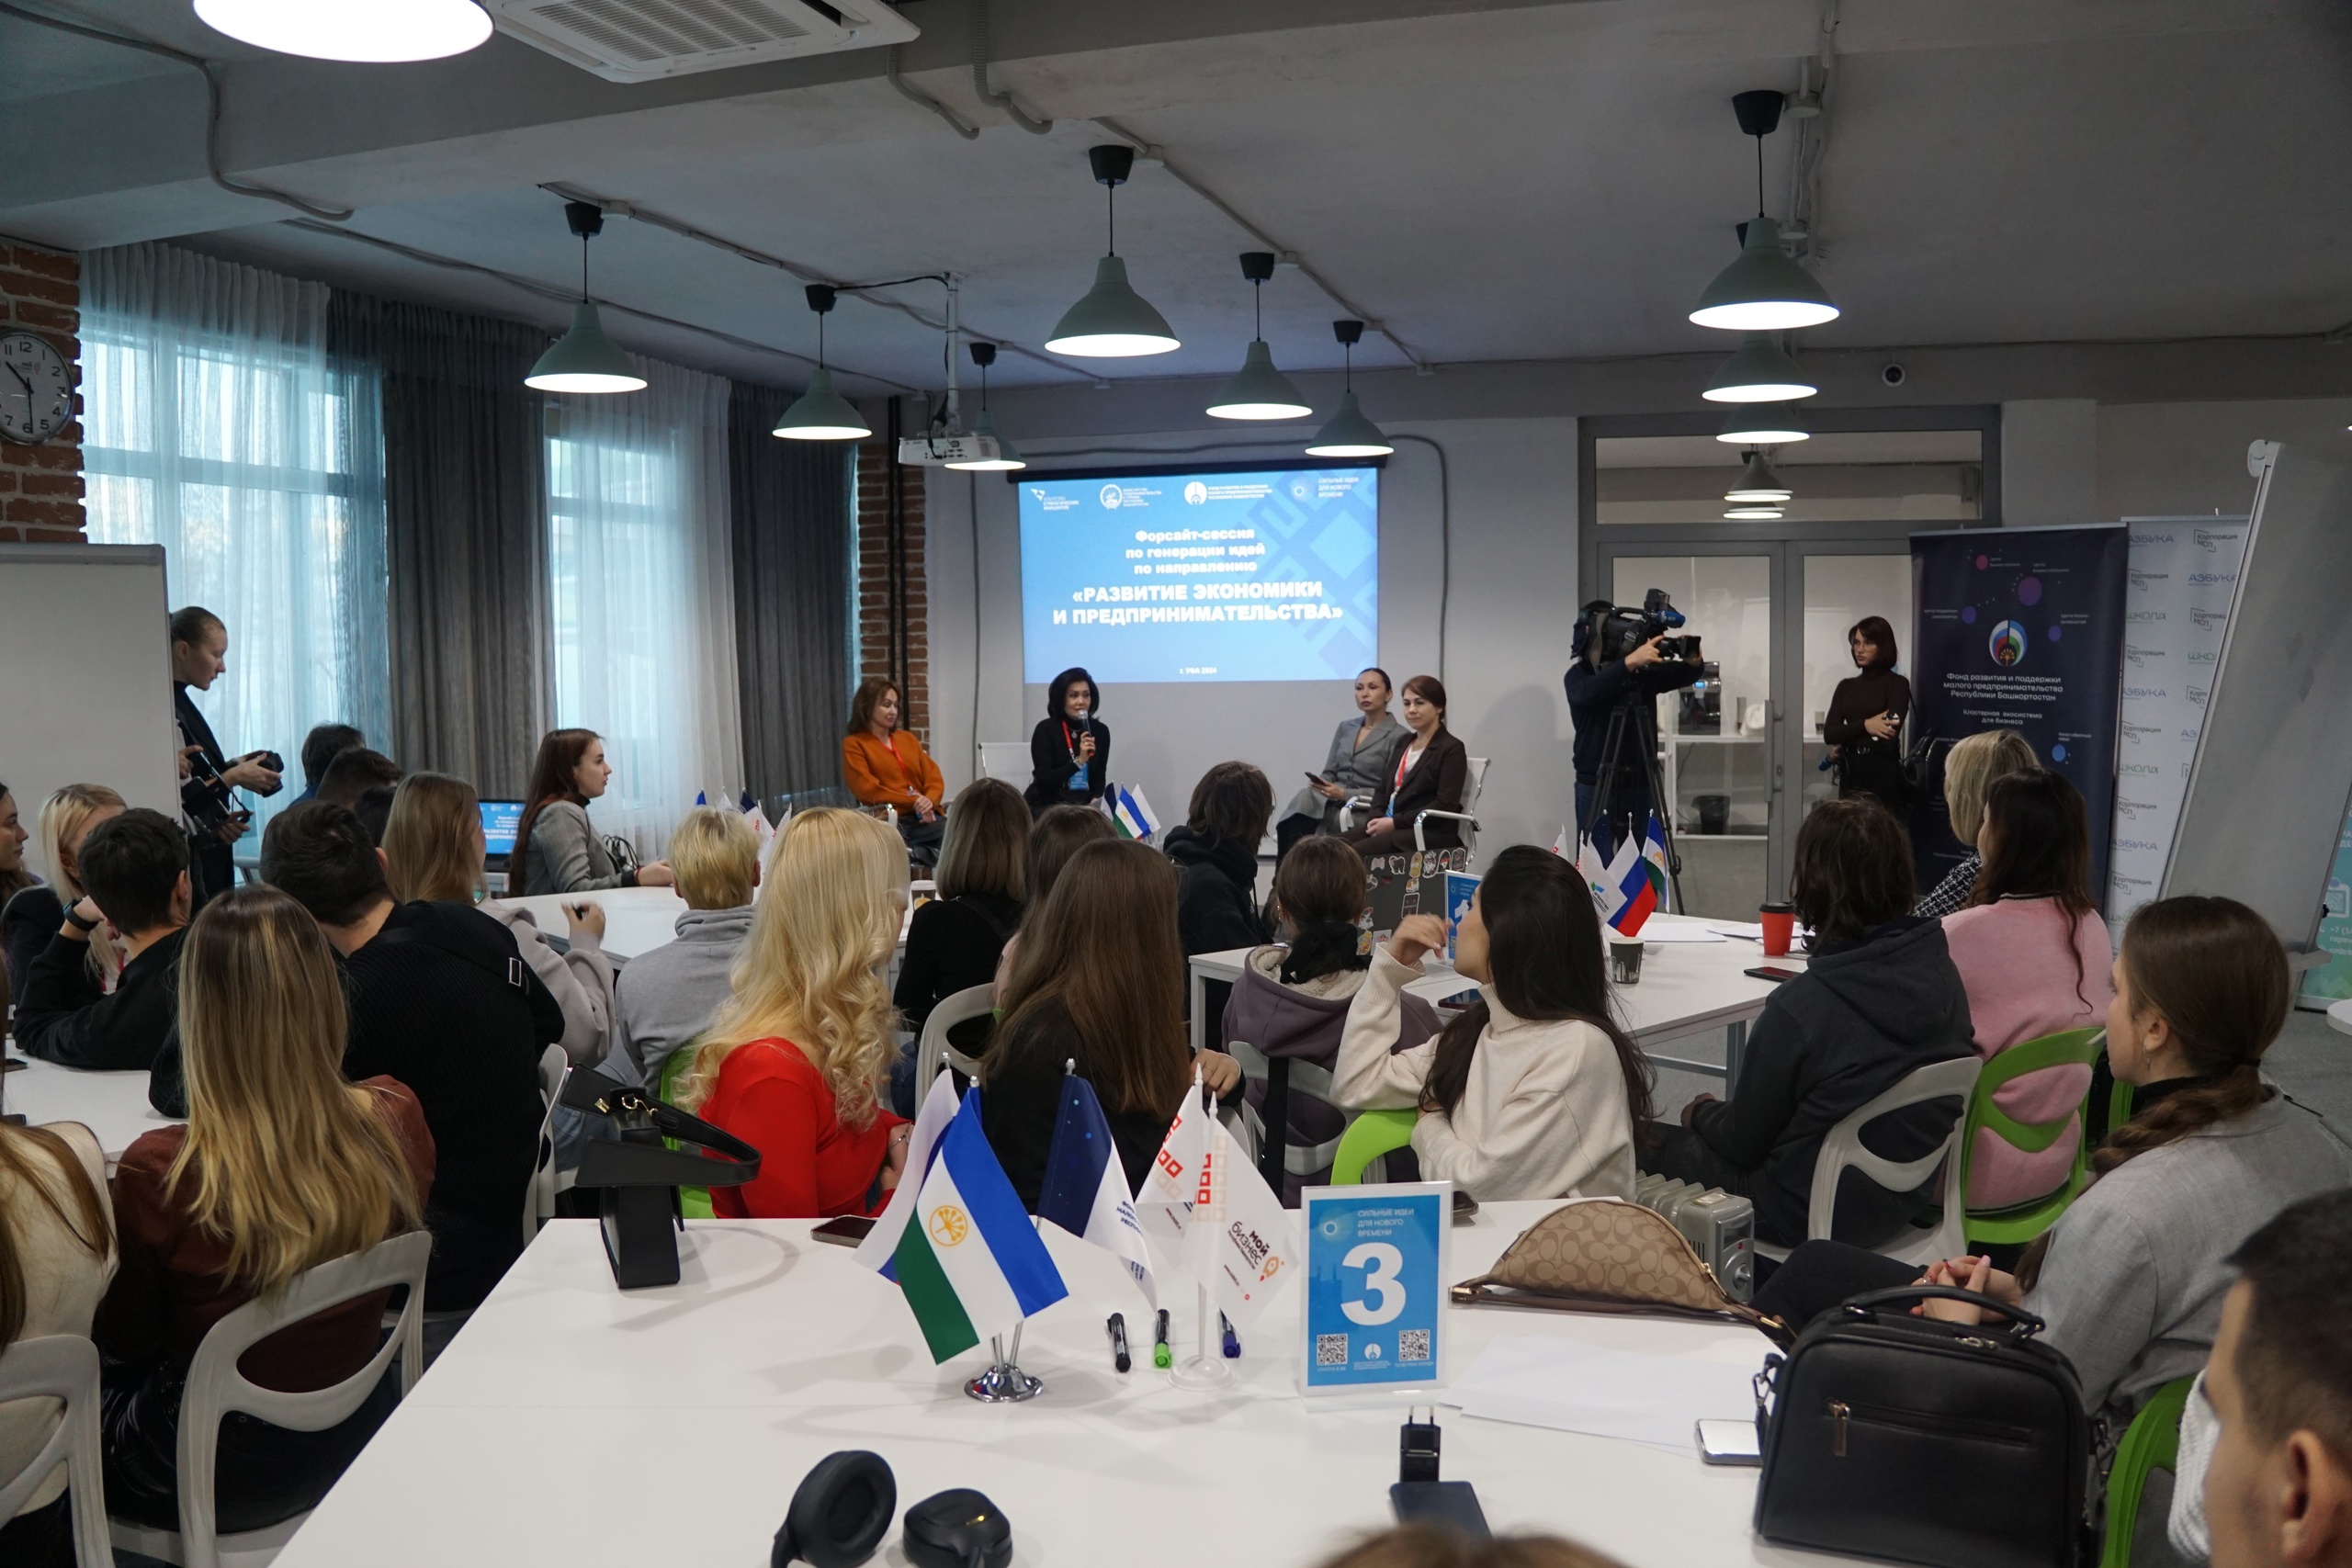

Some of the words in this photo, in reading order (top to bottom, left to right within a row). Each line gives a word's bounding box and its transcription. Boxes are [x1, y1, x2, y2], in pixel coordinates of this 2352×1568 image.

[5, 344, 12, 355] 11
[20, 342, 32, 353] 12
[51, 367, 61, 377] 2
[57, 386, 67, 398] 3
[52, 407, 61, 416] 4
[5, 415, 13, 426] 7
[40, 420, 50, 430] 5
[22, 423, 31, 434] 6
[1136, 528, 1255, 544] Форсайт-сессия
[2129, 535, 2174, 543] АЗБУКА
[1125, 548, 1143, 558] по
[1148, 546, 1225, 559] генерации
[1229, 543, 1265, 558] идей
[1134, 564, 1152, 574] по
[1156, 561, 1257, 575] направлению
[1072, 585, 1187, 603] «РАЗВИТИЕ
[1193, 581, 1322, 600] ЭКОНОМИКИ
[1053, 610, 1067, 625] И
[1072, 604, 1343, 626] ПРЕДПРИНИМАТЕЛЬСТВА»
[2126, 612, 2166, 620] ШКОЛА
[2194, 618, 2209, 626] МСП
[2127, 655, 2141, 663] МСП
[2188, 652, 2217, 661] ШКО
[1201, 666, 1217, 674] 2024
[1947, 672, 1969, 682] Фонд
[1971, 673, 2007, 682] развития
[2015, 675, 2061, 684] поддержки
[1973, 682, 2063, 693] предпринимательства
[1951, 691, 1996, 699] Республики
[1997, 692, 2055, 701] Башкортостан
[2189, 696, 2204, 705] МСП
[1963, 709, 2000, 717] Кластерная
[2003, 711, 2042, 719] экосистема
[2123, 730, 2136, 739] МСП
[2119, 801, 2156, 810] Корпорация
[2119, 807, 2132, 816] МСП
[2114, 875, 2152, 886] Корпорация
[2113, 882, 2128, 891] МСП
[1232, 1221, 1261, 1265] бизнес
[1250, 1230, 1270, 1257] мой
[1340, 1242, 1407, 1325] 3
